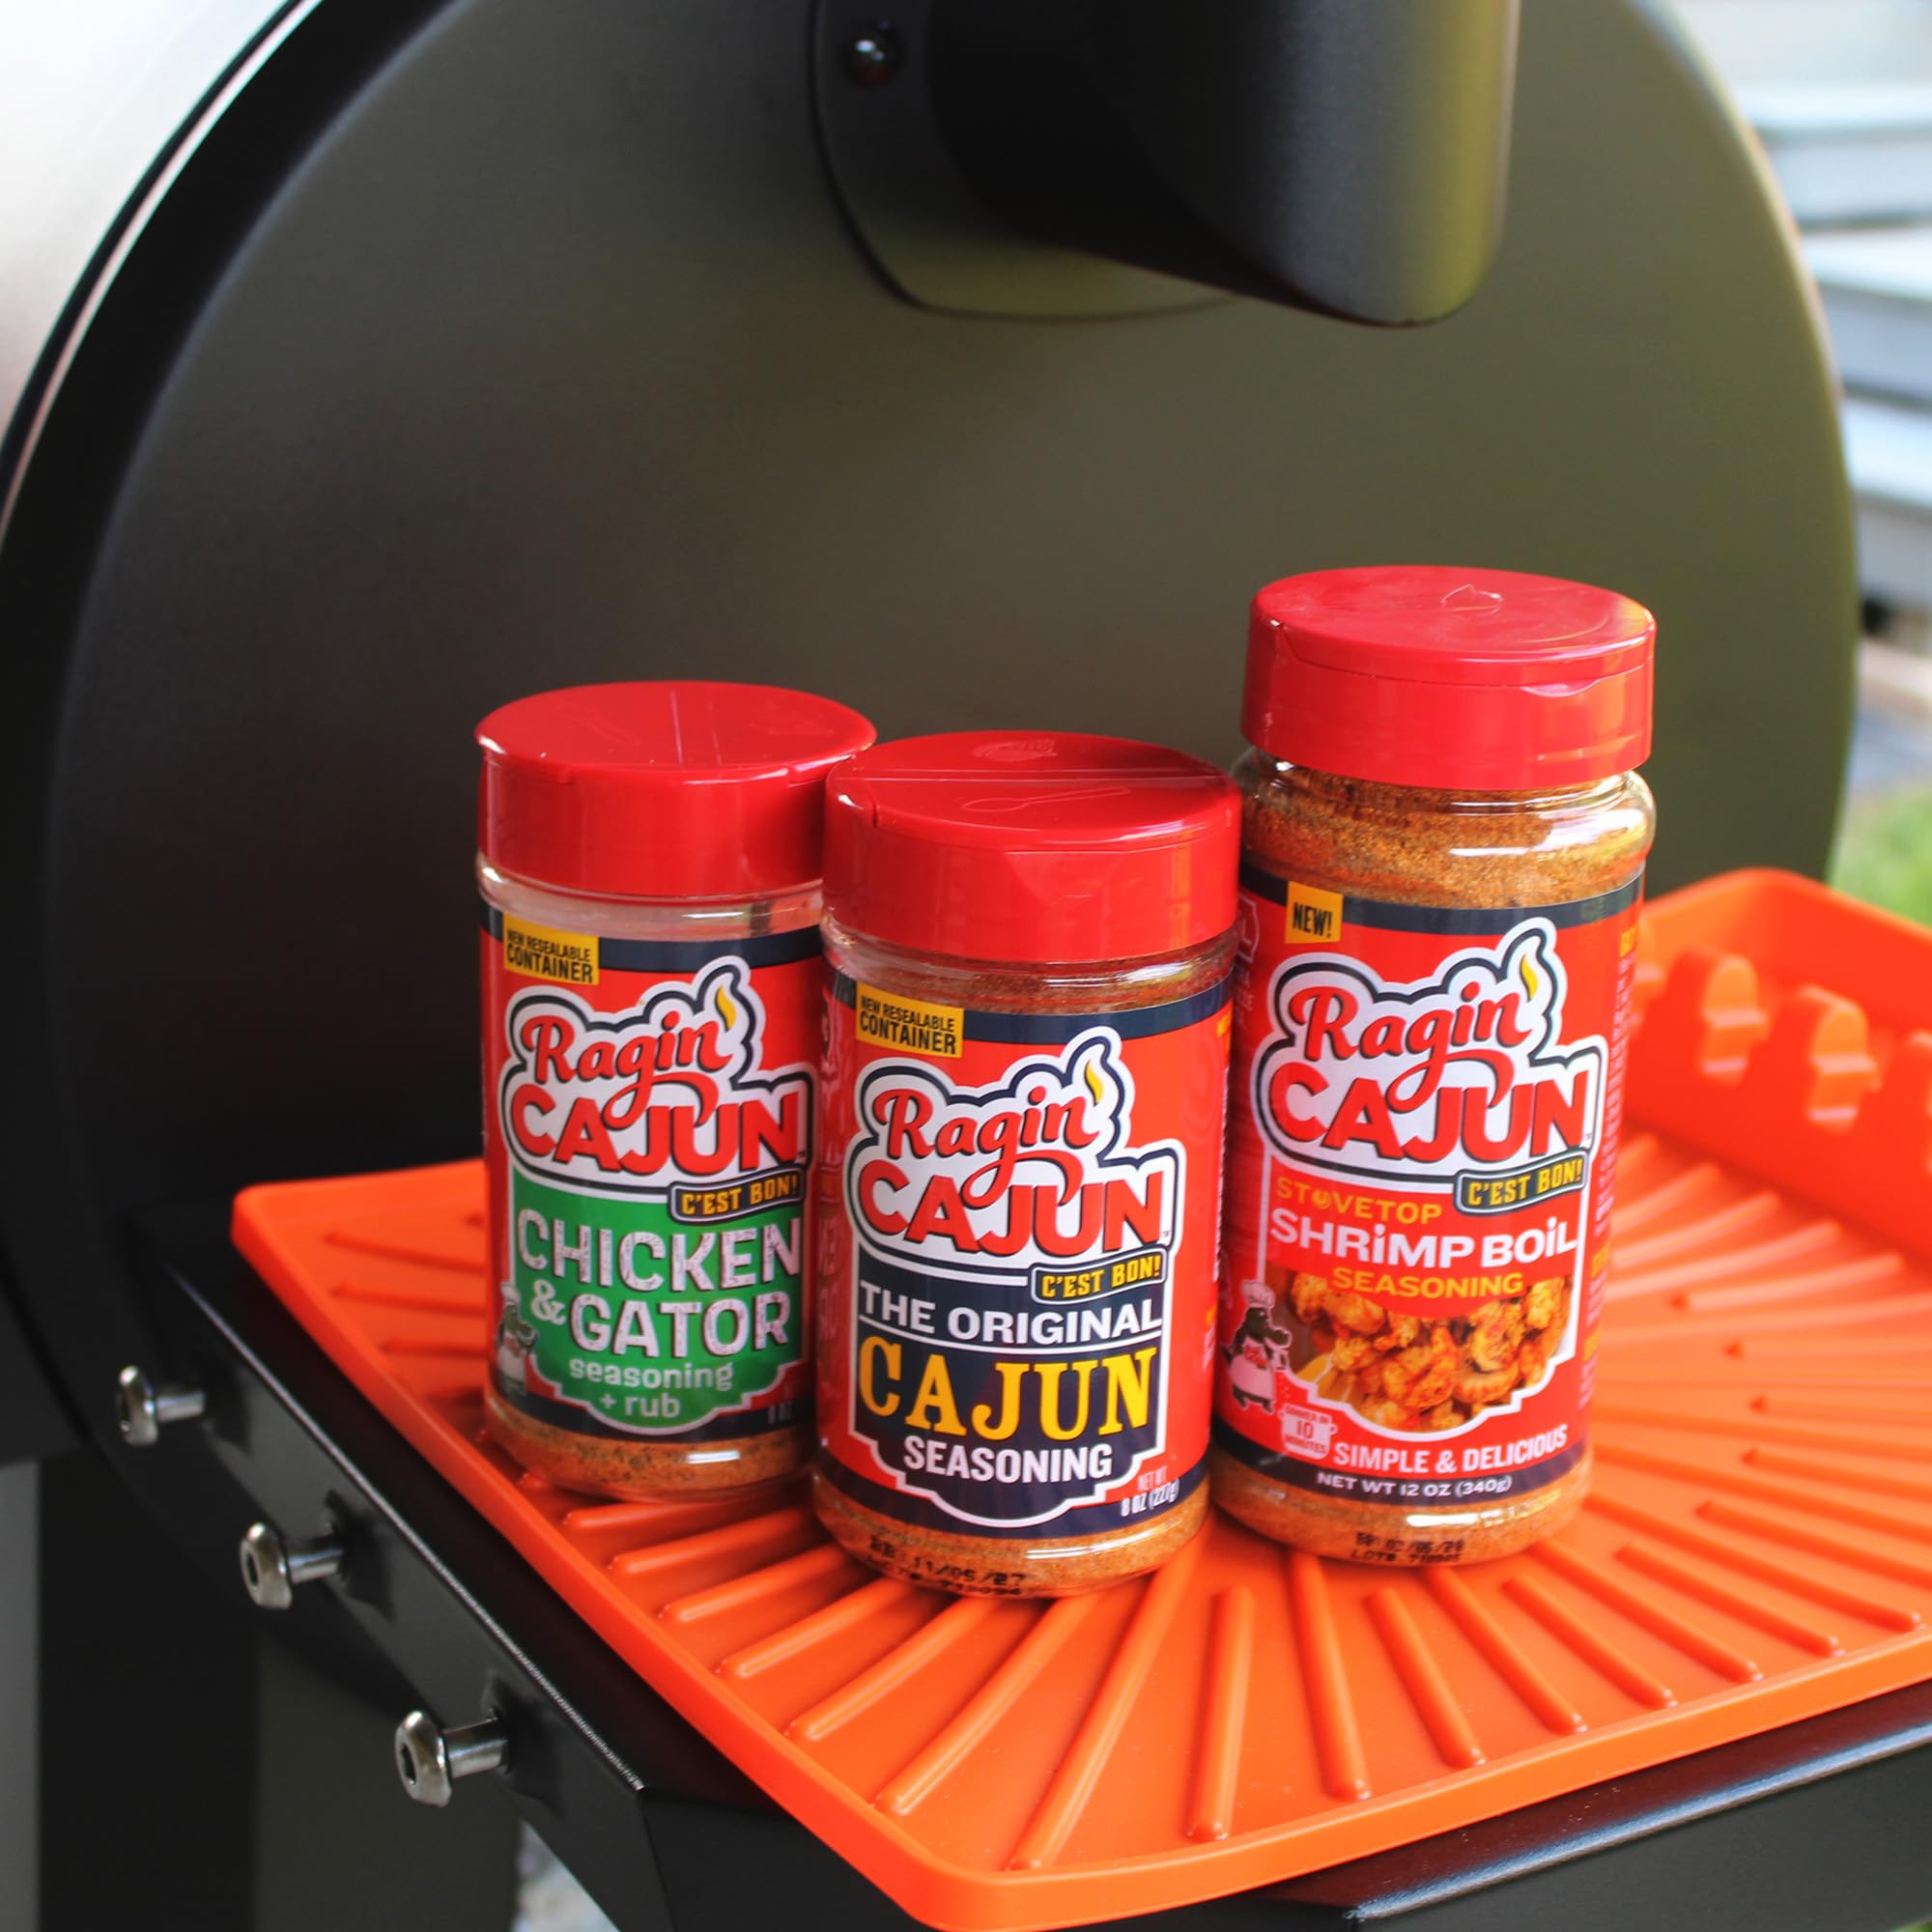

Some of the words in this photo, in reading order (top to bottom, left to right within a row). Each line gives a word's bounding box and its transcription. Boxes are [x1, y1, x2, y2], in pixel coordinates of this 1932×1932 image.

[1293, 901, 1332, 938] NEW!
[506, 942, 593, 983] CONTAINER
[860, 1010, 956, 1055] CONTAINER
[883, 1003, 954, 1033] RESEALABLE
[510, 1083, 801, 1175] CAJUN
[1269, 1061, 1592, 1162] CAJUN
[681, 1189, 741, 1215] C'EST
[750, 1174, 798, 1203] BON!
[1277, 1178, 1442, 1225] STOVETOP
[1467, 1176, 1530, 1208] C'EST
[1538, 1160, 1583, 1193] BON!
[858, 1160, 1165, 1256] CAJUN
[517, 1208, 801, 1293] CHICKEN
[1040, 1268, 1103, 1299] C'EST
[1111, 1255, 1161, 1288] BON!
[1332, 1266, 1523, 1299] SEASONING
[530, 1279, 567, 1326] &
[570, 1291, 791, 1358] GATOR
[860, 1280, 936, 1334] THE
[948, 1299, 1162, 1346] ORIGINAL
[569, 1358, 734, 1391] seasoning
[859, 1335, 1157, 1441] CAJUN
[624, 1394, 680, 1418] rub
[1297, 1420, 1314, 1438] 10
[904, 1435, 1113, 1484] SEASONING
[1334, 1442, 1430, 1473] SIMPLE
[1436, 1450, 1457, 1473] &
[1466, 1424, 1568, 1472] DELICIOUS
[1317, 1471, 1357, 1490] NET
[1361, 1479, 1397, 1494] WT
[1400, 1484, 1419, 1496] 12
[1423, 1484, 1452, 1497] OZ
[1456, 1475, 1513, 1497] (340g)
